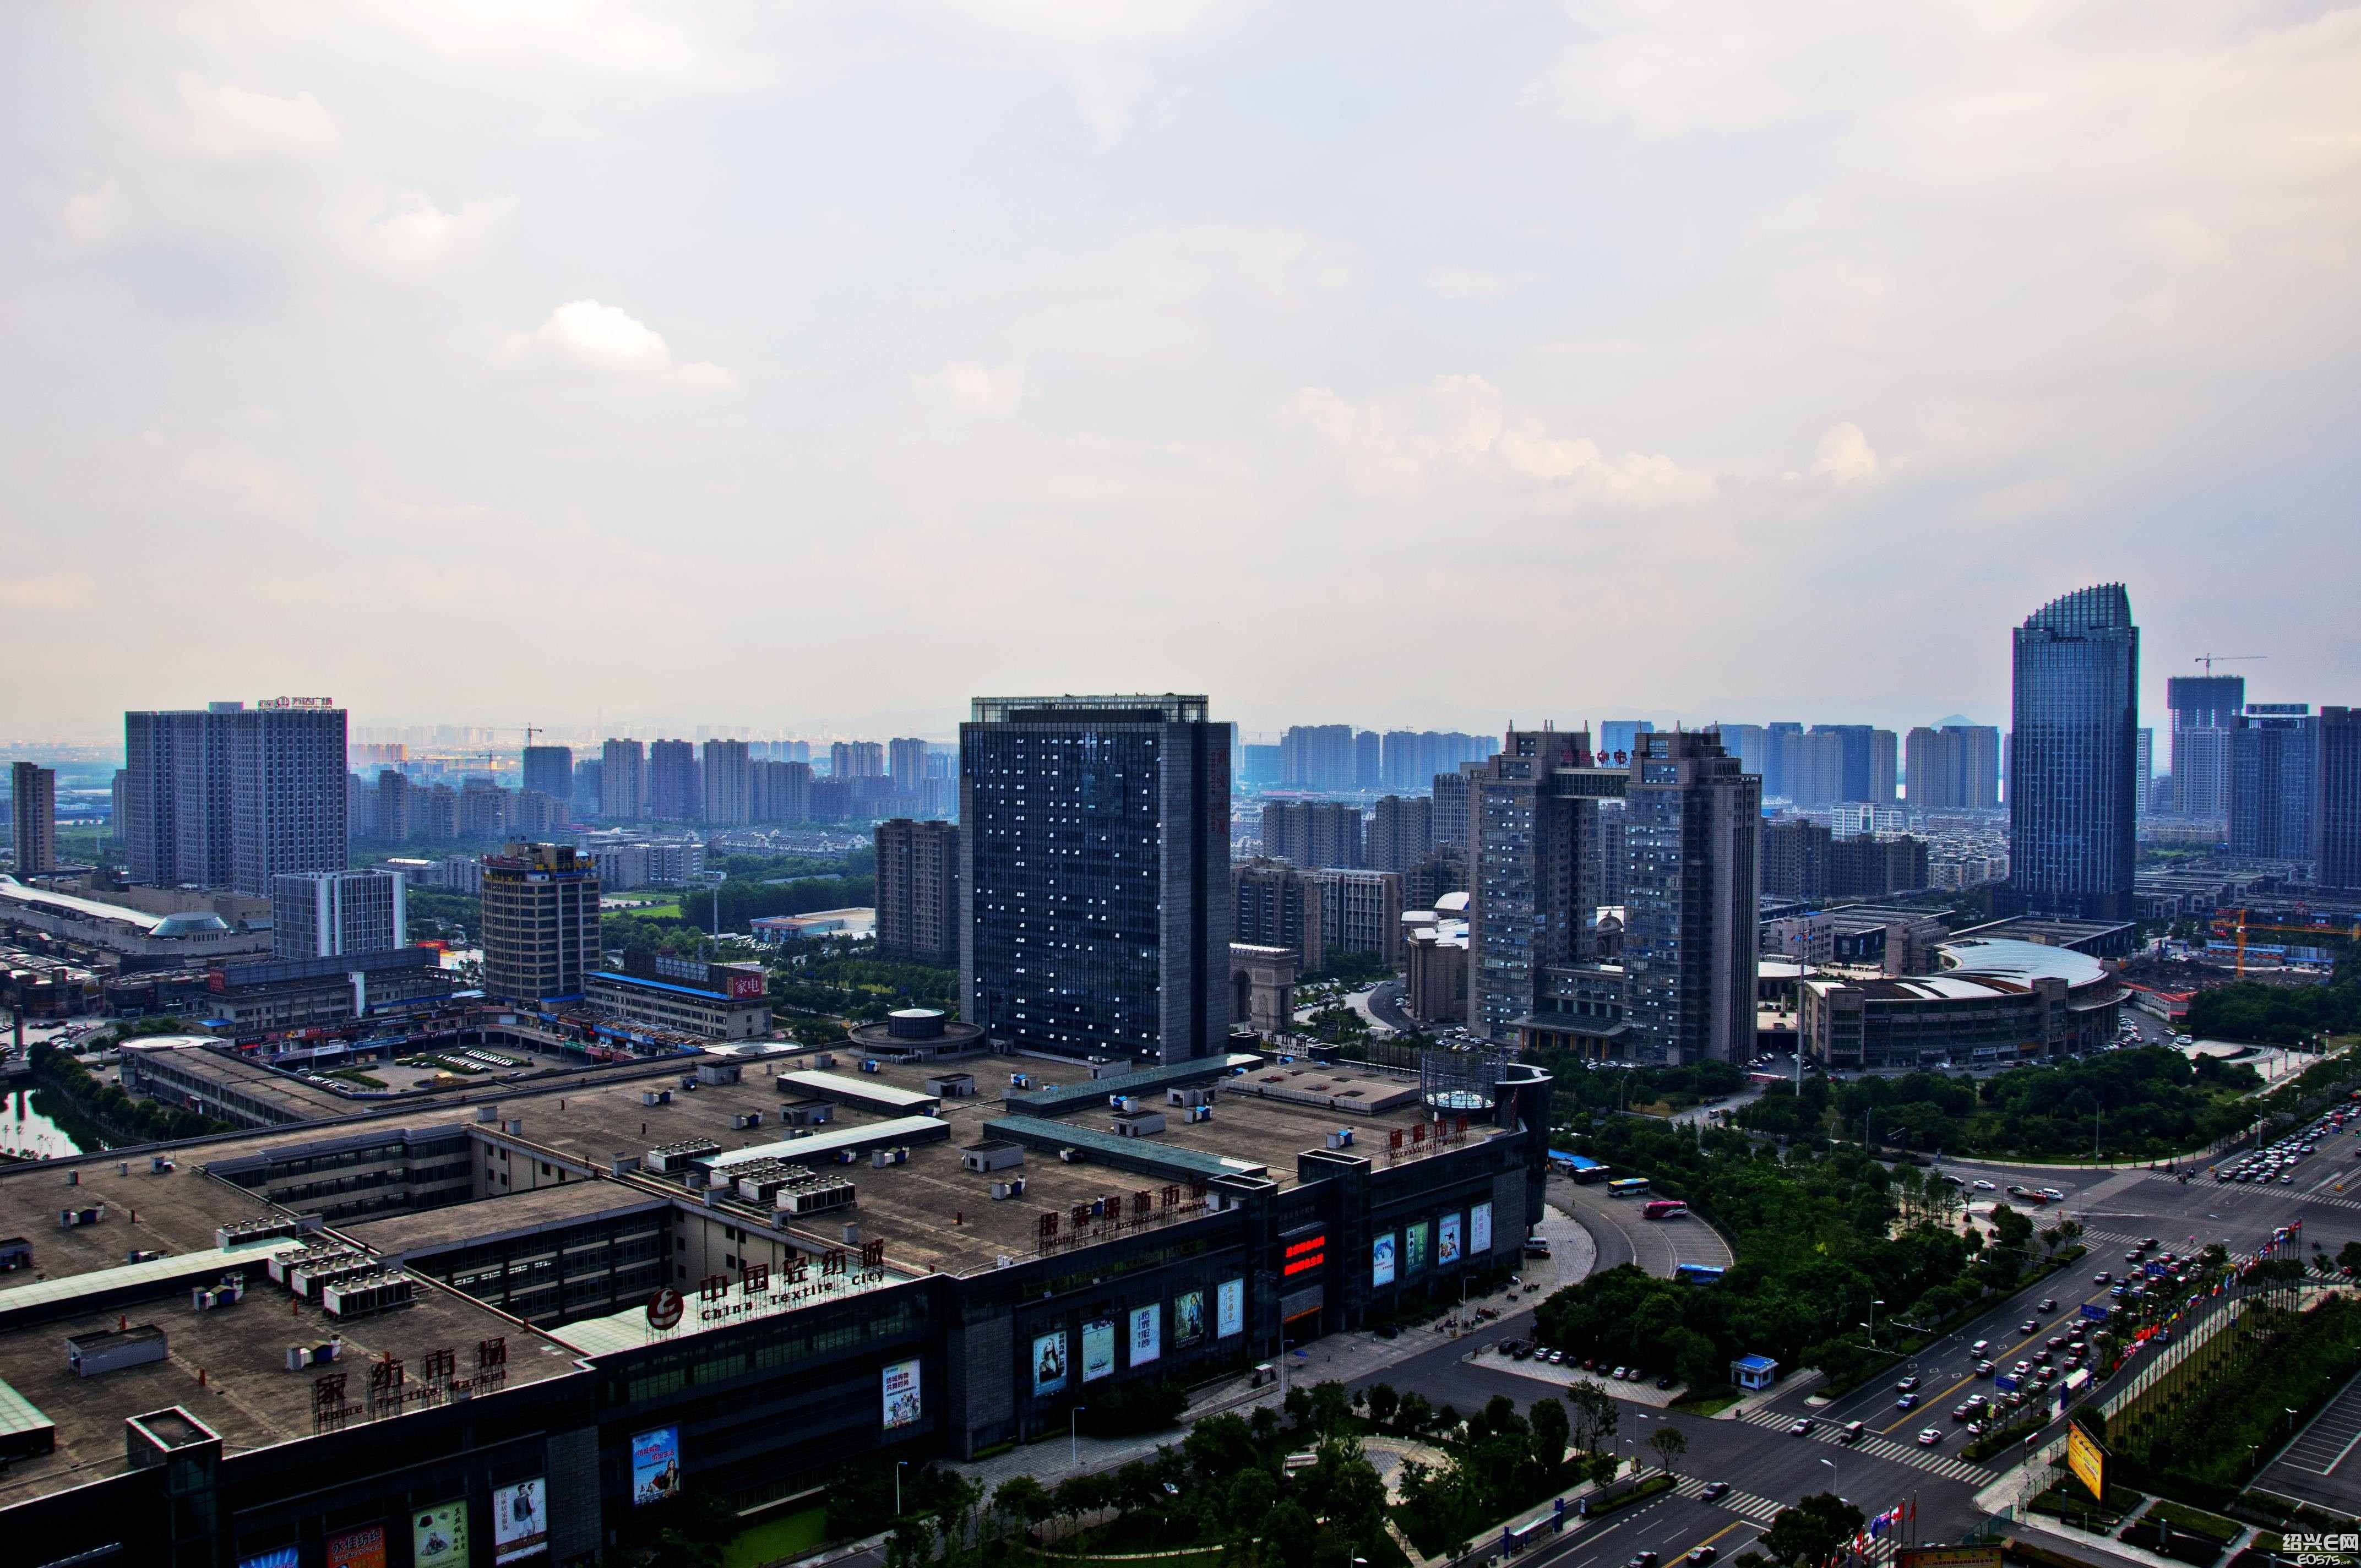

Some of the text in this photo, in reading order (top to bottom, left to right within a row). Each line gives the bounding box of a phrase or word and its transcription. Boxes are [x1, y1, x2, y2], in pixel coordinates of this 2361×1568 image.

[736, 978, 759, 994] 家电
[700, 1238, 884, 1303] 中国轻纺城
[701, 1300, 753, 1321] China
[770, 1281, 834, 1305] Textile
[316, 1337, 507, 1405] 家纺市场
[318, 1403, 363, 1422] Home
